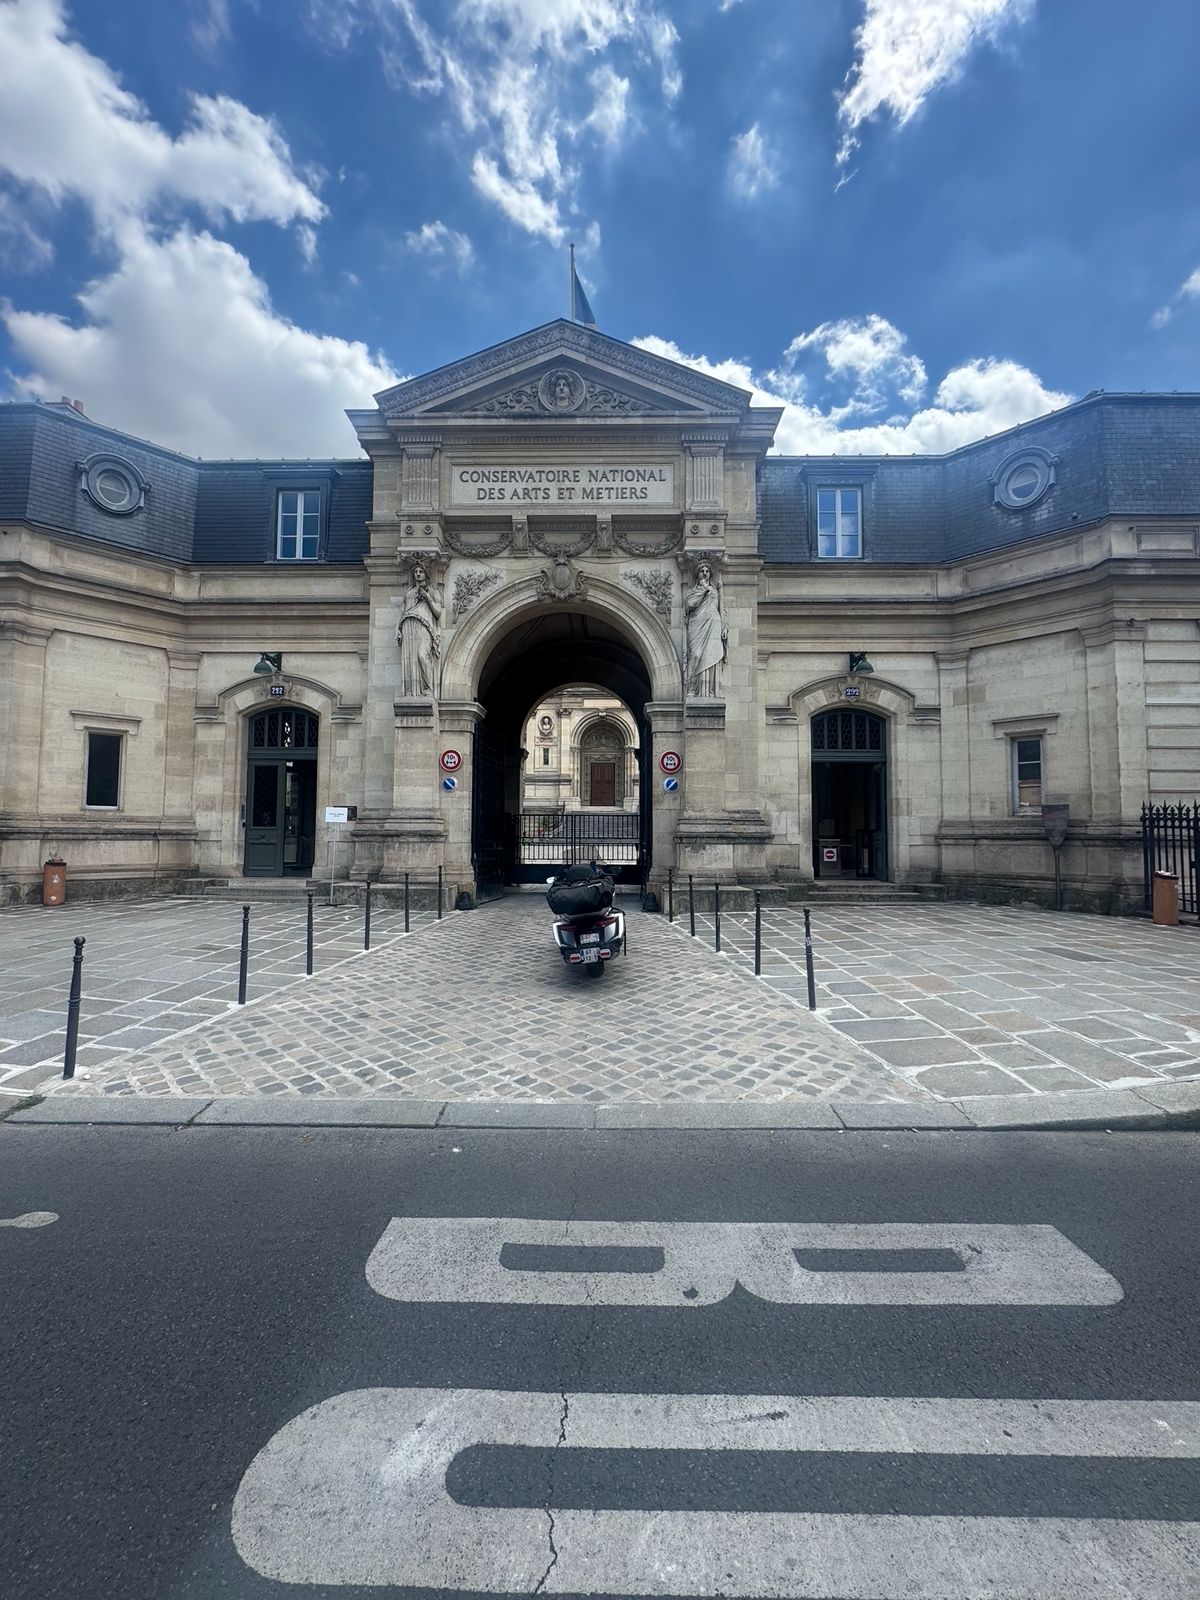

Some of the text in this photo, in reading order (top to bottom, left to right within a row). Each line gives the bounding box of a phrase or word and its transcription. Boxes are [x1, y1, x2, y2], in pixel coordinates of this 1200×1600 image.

[460, 469, 667, 483] CONSERVATOIRE NATIONAL
[477, 486, 649, 500] DES ARTS ET METIERS
